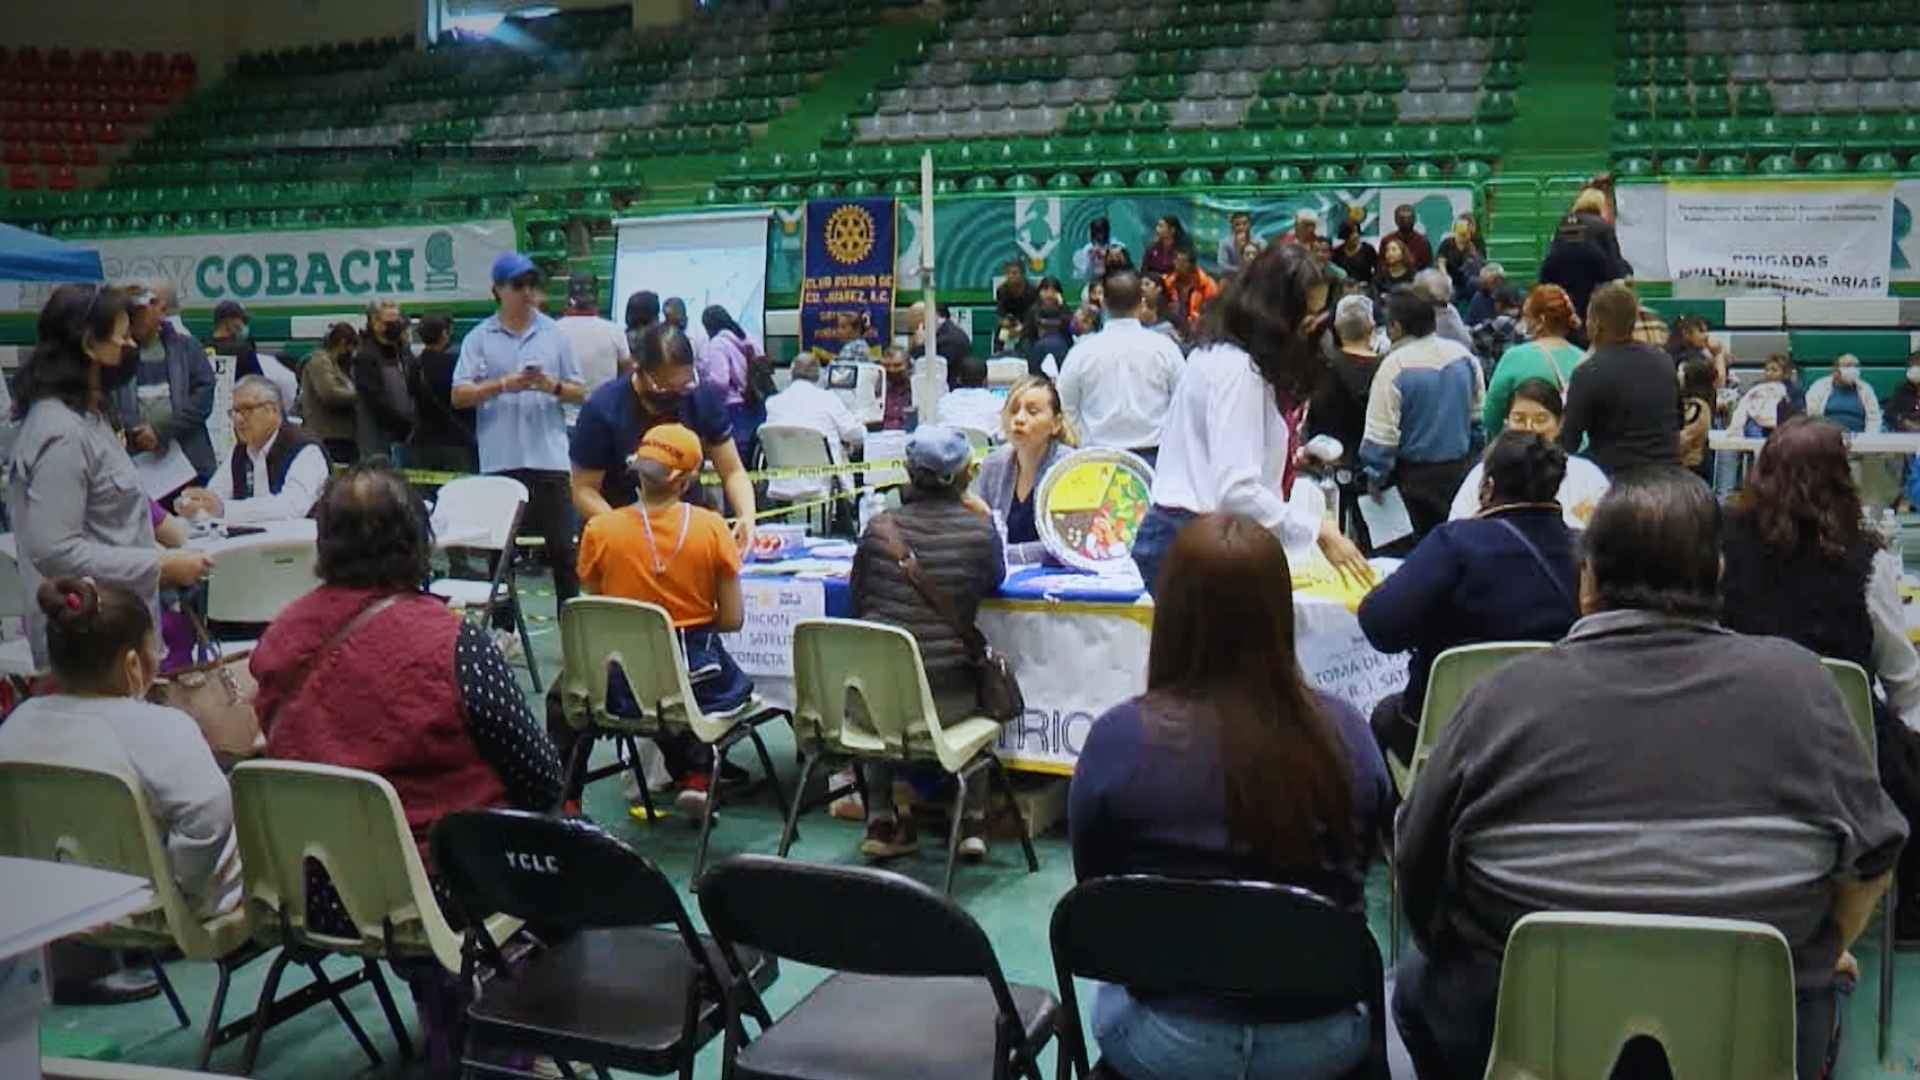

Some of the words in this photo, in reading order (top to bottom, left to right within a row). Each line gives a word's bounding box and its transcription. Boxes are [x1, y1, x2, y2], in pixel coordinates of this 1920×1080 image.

[196, 248, 415, 298] COBACH
[1732, 254, 1829, 269] BRIGADAS
[505, 848, 560, 873] YCLC
